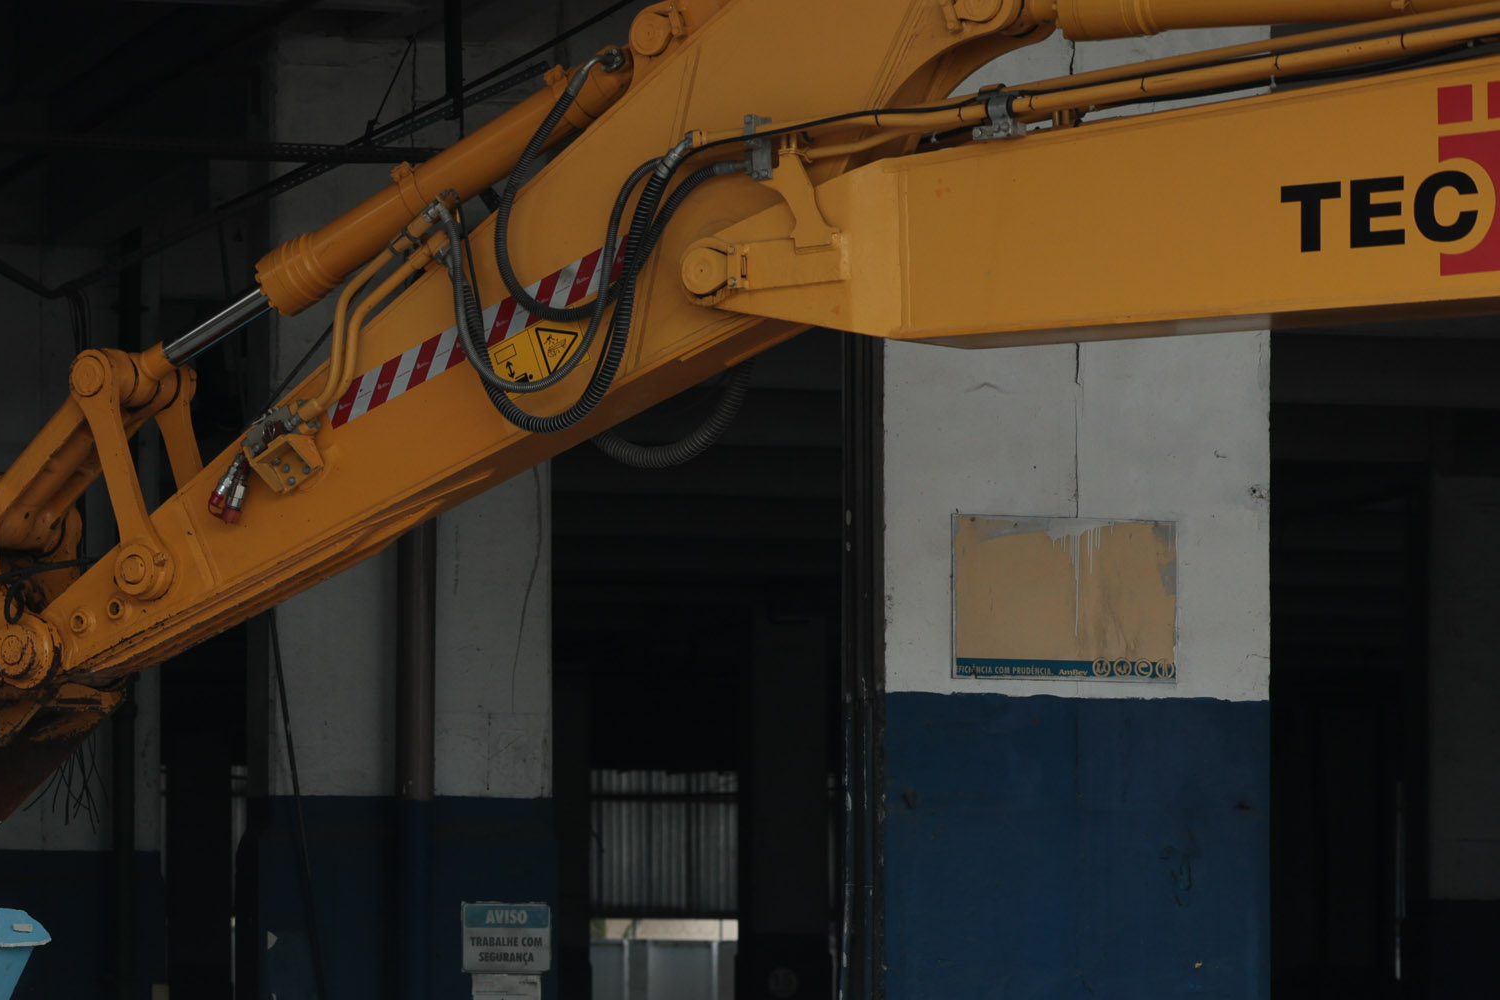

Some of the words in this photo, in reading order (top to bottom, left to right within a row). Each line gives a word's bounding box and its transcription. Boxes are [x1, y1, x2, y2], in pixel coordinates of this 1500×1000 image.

[994, 665, 1010, 674] COM
[485, 909, 528, 924] AVISO
[469, 936, 519, 947] TRABALHE
[521, 936, 543, 947] COM
[478, 952, 535, 965] SEGURANÇA
